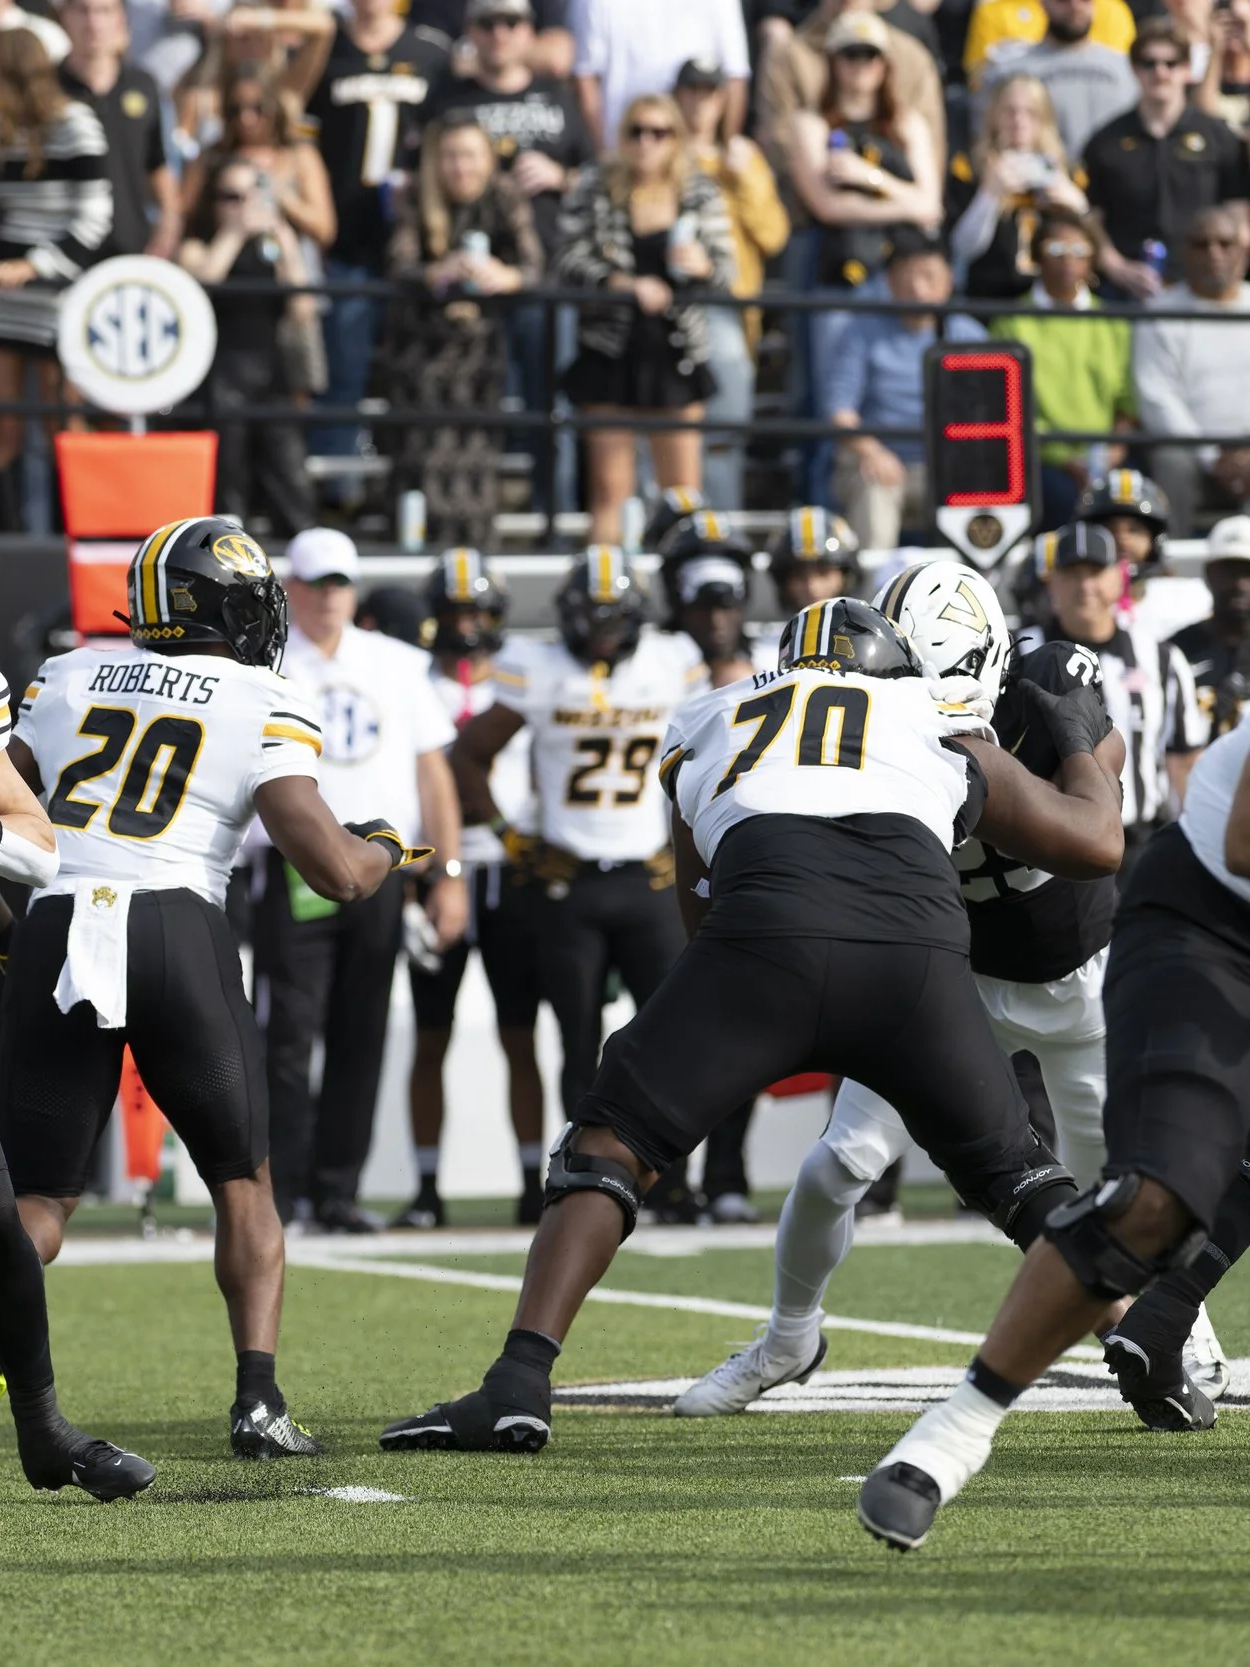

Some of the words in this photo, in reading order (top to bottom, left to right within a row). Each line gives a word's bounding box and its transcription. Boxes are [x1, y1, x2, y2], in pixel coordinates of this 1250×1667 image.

[88, 282, 181, 376] SEC
[942, 354, 1025, 507] 3
[938, 580, 989, 634] V
[88, 664, 220, 705] ROBERTS
[48, 704, 206, 842] 20
[564, 736, 660, 806] 29
[710, 682, 872, 802] 70
[1013, 1168, 1053, 1195] DONJOY
